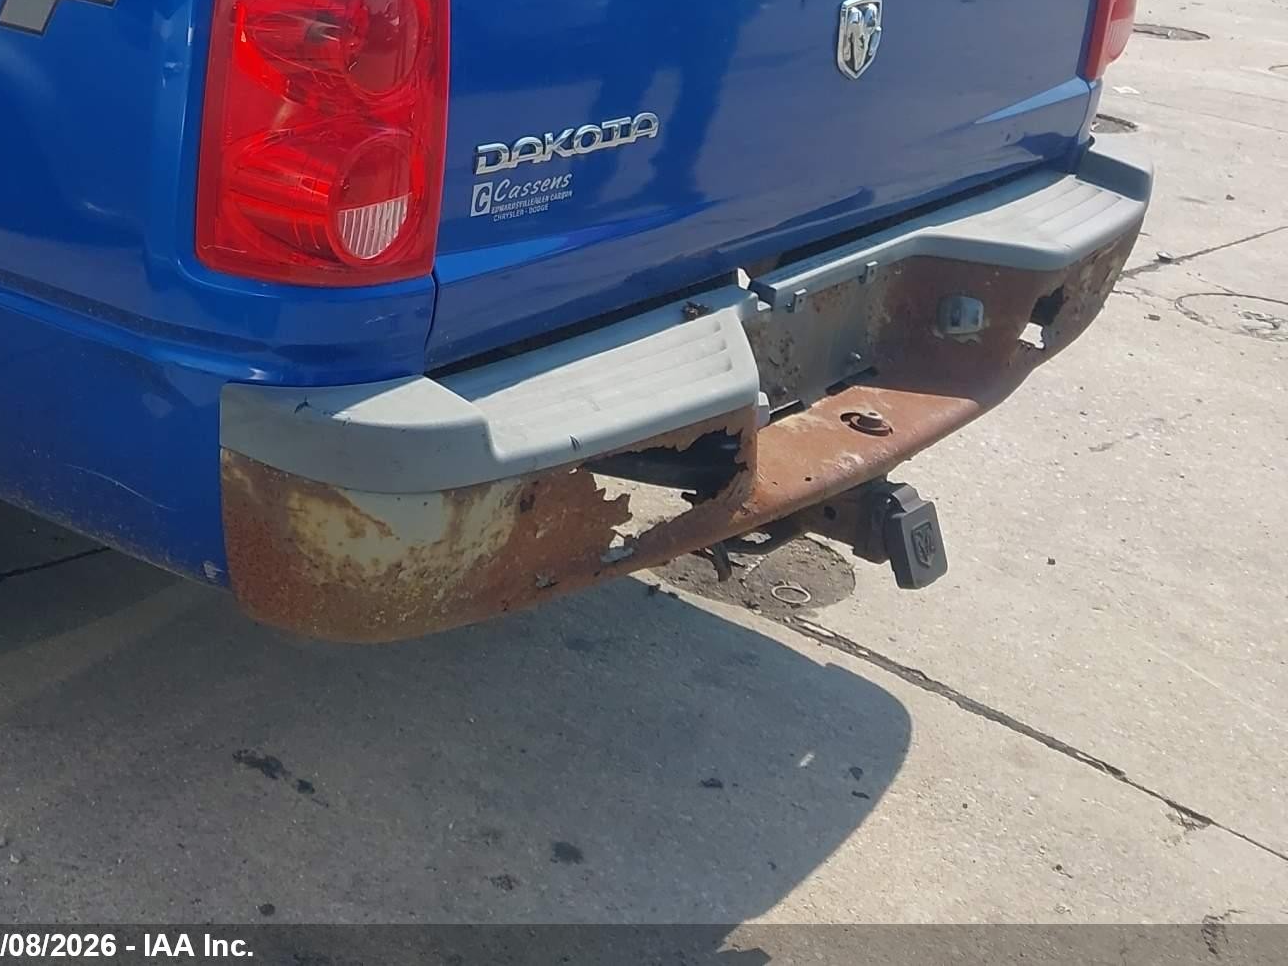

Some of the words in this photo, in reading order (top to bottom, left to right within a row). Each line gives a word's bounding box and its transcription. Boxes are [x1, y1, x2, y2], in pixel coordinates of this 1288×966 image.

[475, 112, 659, 175] DAKOTA
[493, 173, 573, 202] Cassens
[493, 209, 524, 222] CHRYSLER
[528, 204, 549, 214] DODGE
